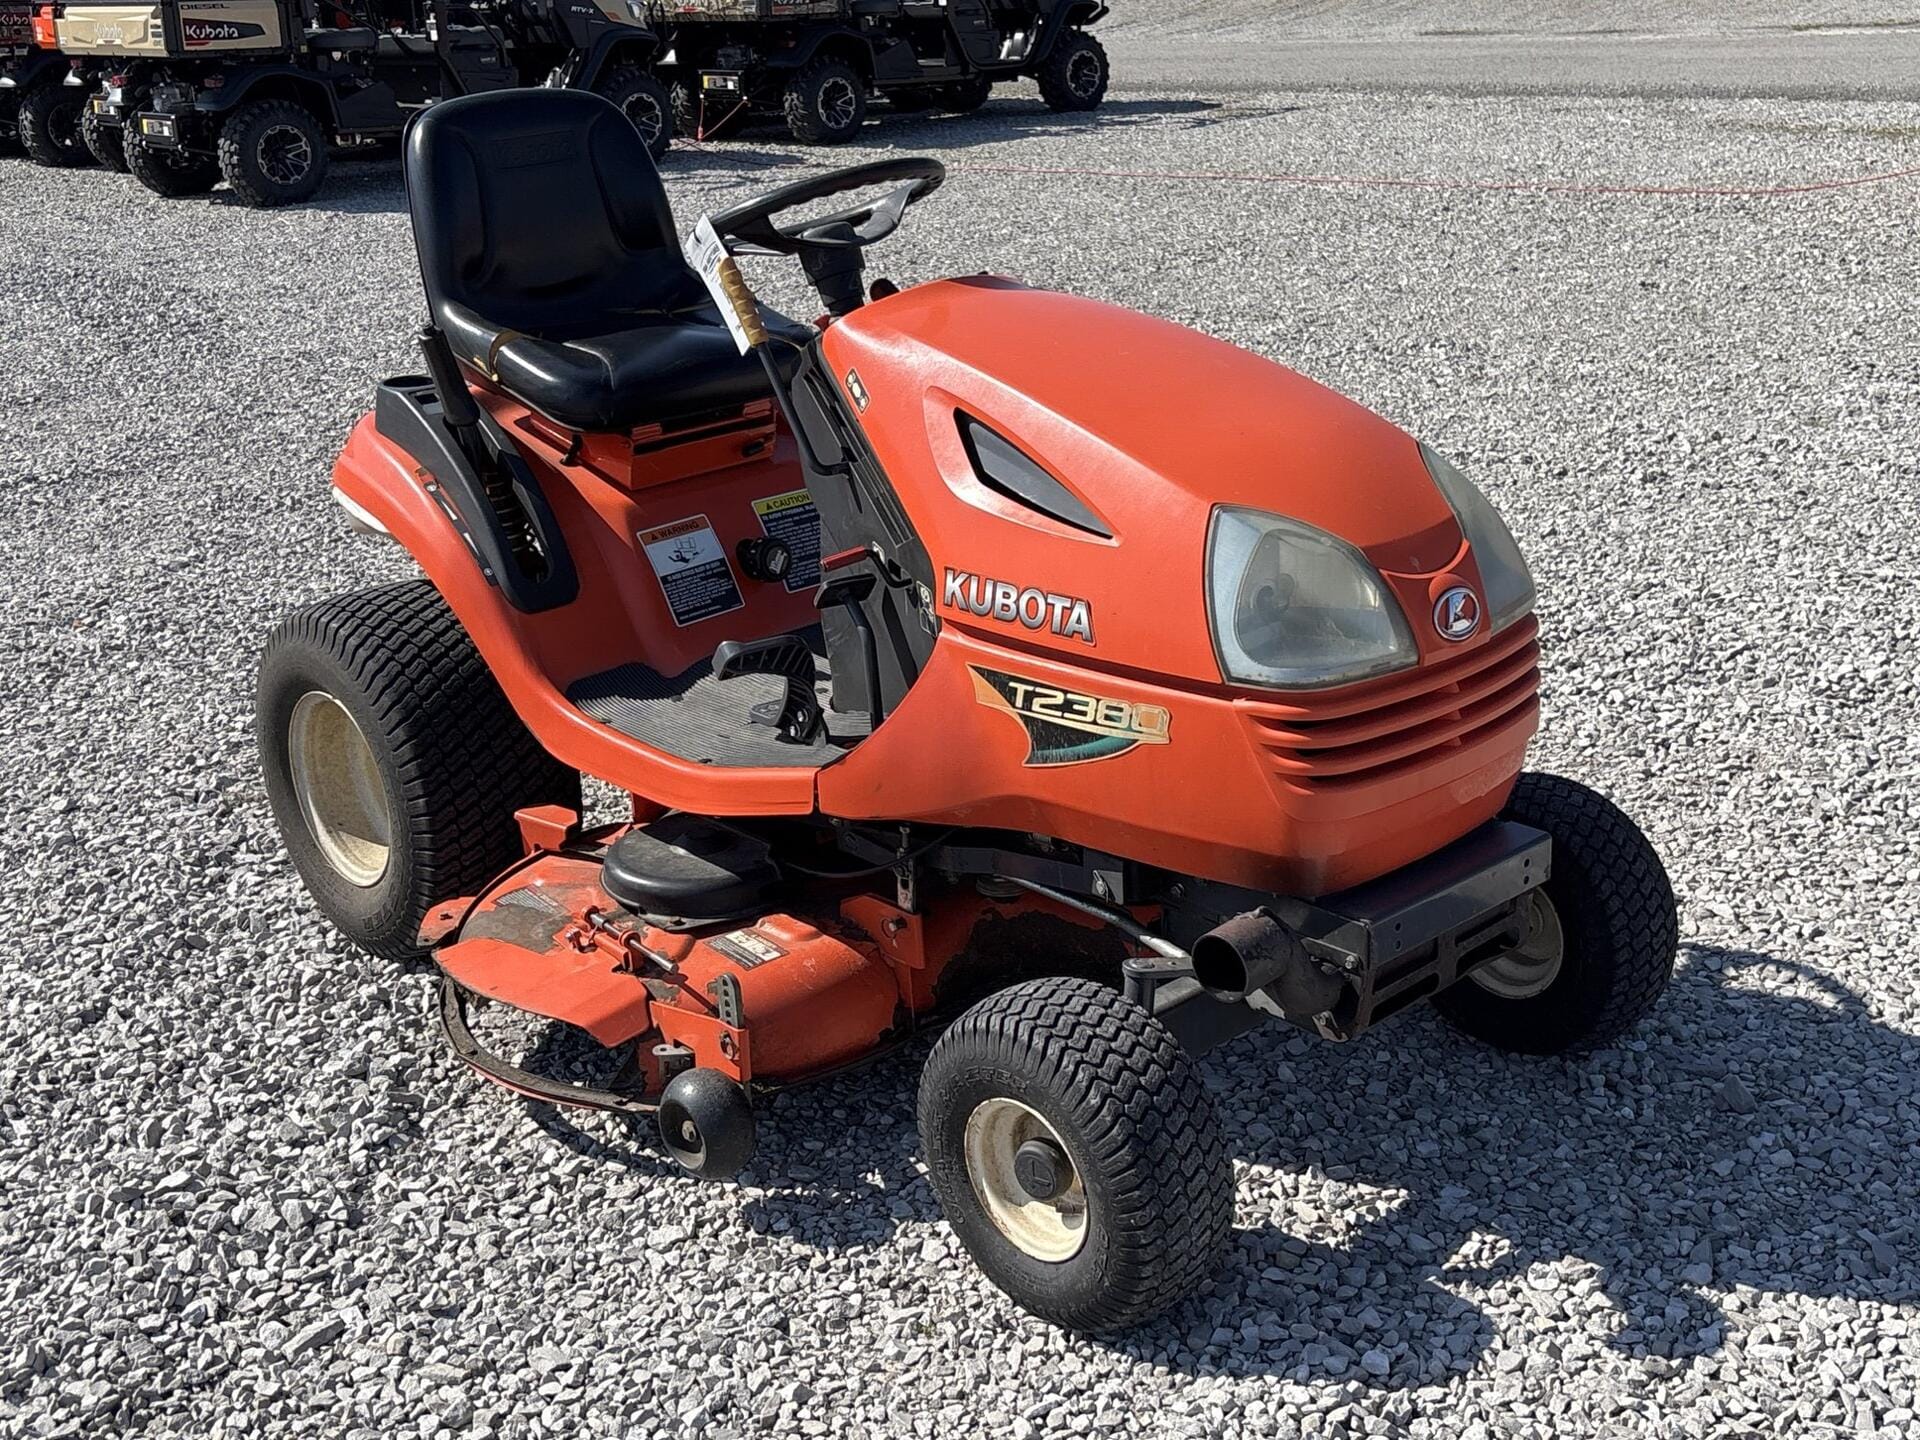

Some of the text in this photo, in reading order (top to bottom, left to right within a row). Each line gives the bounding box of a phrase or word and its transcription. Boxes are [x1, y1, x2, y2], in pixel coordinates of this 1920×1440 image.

[571, 5, 595, 14] RTV-X
[94, 22, 123, 38] Kubota
[185, 24, 239, 39] Kubota
[773, 493, 810, 508] CAUTION
[658, 521, 700, 538] WARNING
[944, 567, 1094, 643] KUBOTA
[1008, 681, 1169, 733] T2380
